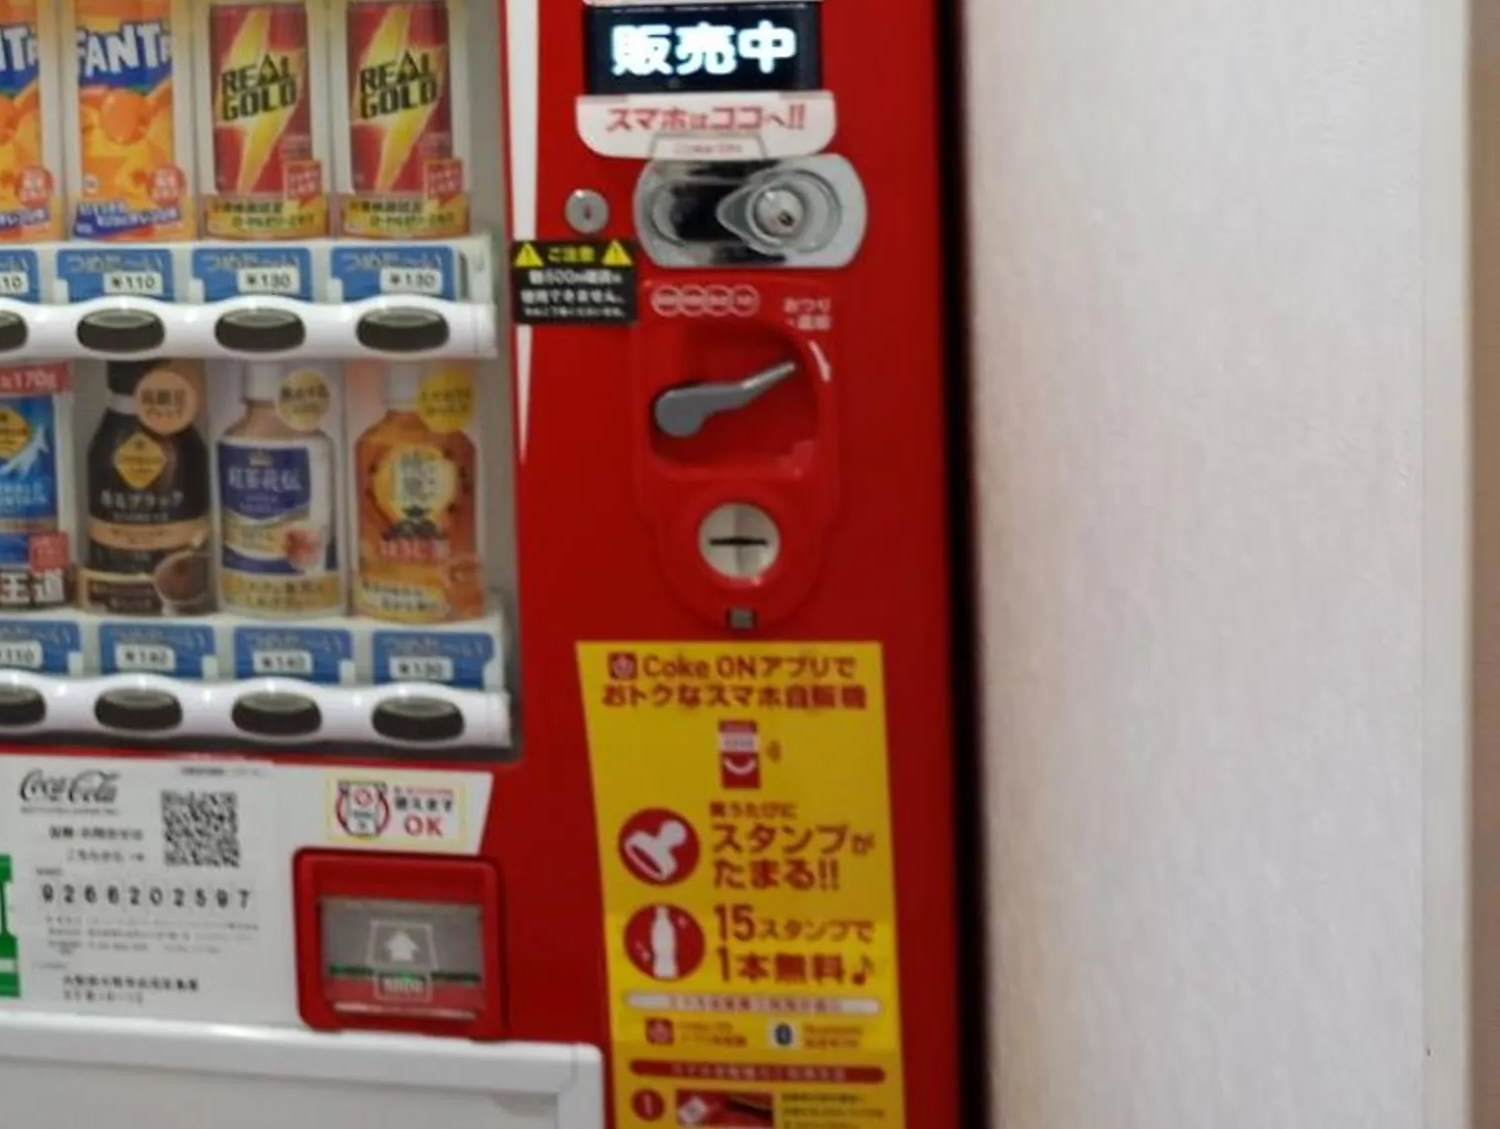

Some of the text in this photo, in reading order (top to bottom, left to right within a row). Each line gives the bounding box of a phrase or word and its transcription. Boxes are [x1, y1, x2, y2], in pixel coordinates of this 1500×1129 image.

[611, 19, 797, 76] 販売中
[222, 53, 291, 94] REAL
[360, 49, 431, 93] REAL
[222, 78, 298, 122] GOLD
[361, 76, 438, 120] GOLD
[643, 654, 709, 678] Coke
[404, 815, 444, 838] OK
[712, 823, 874, 855] スタンプが
